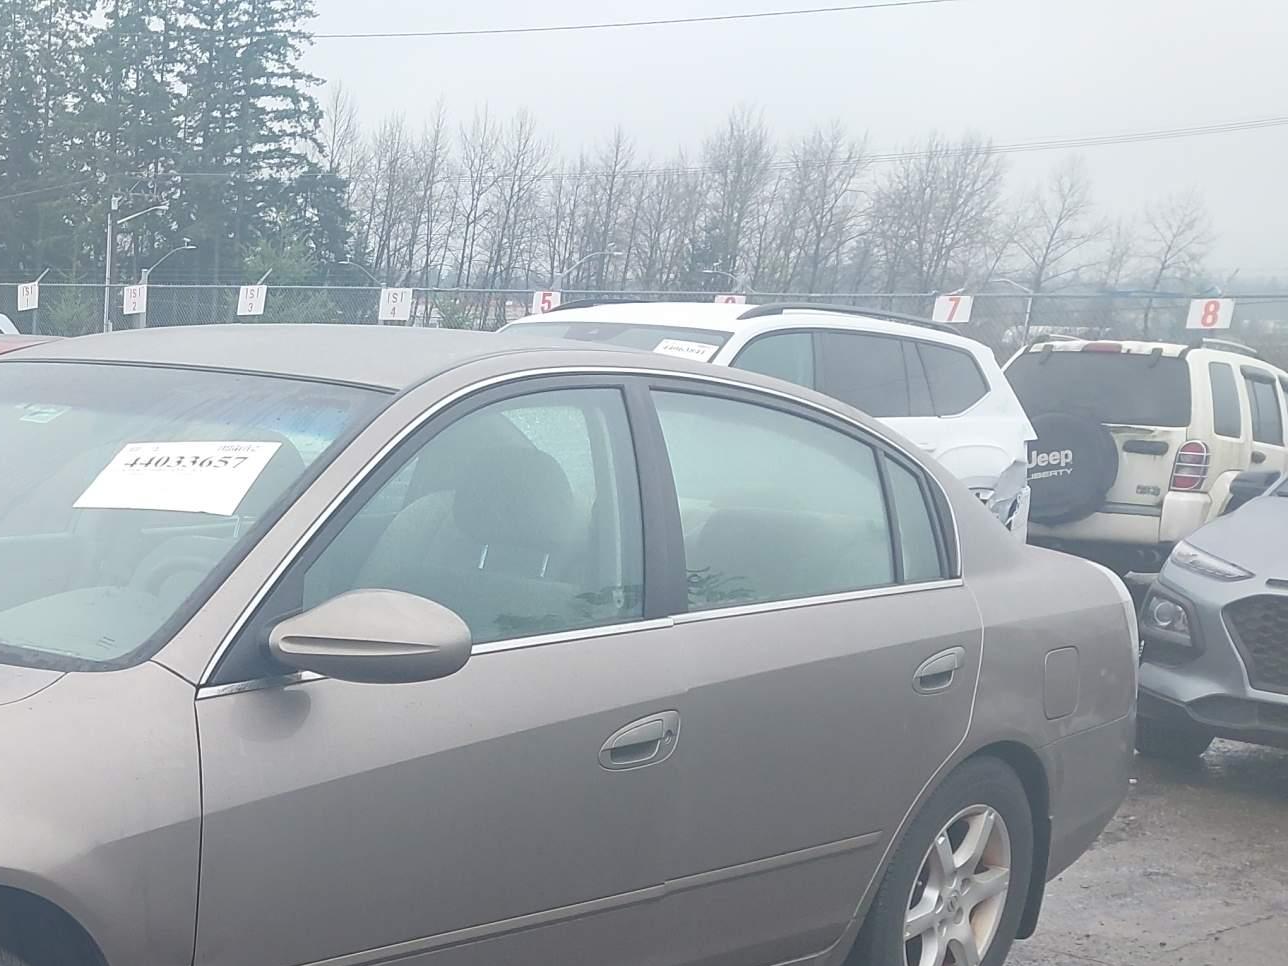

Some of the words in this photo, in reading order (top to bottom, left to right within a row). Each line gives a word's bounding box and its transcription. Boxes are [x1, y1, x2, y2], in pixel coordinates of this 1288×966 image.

[132, 301, 137, 311] 2
[247, 302, 254, 312] 3
[540, 292, 553, 313] 5
[946, 297, 961, 321] 7
[390, 306, 397, 318] 4
[1200, 300, 1221, 328] 8
[124, 456, 249, 469] 44033657
[1027, 449, 1073, 468] Jeep
